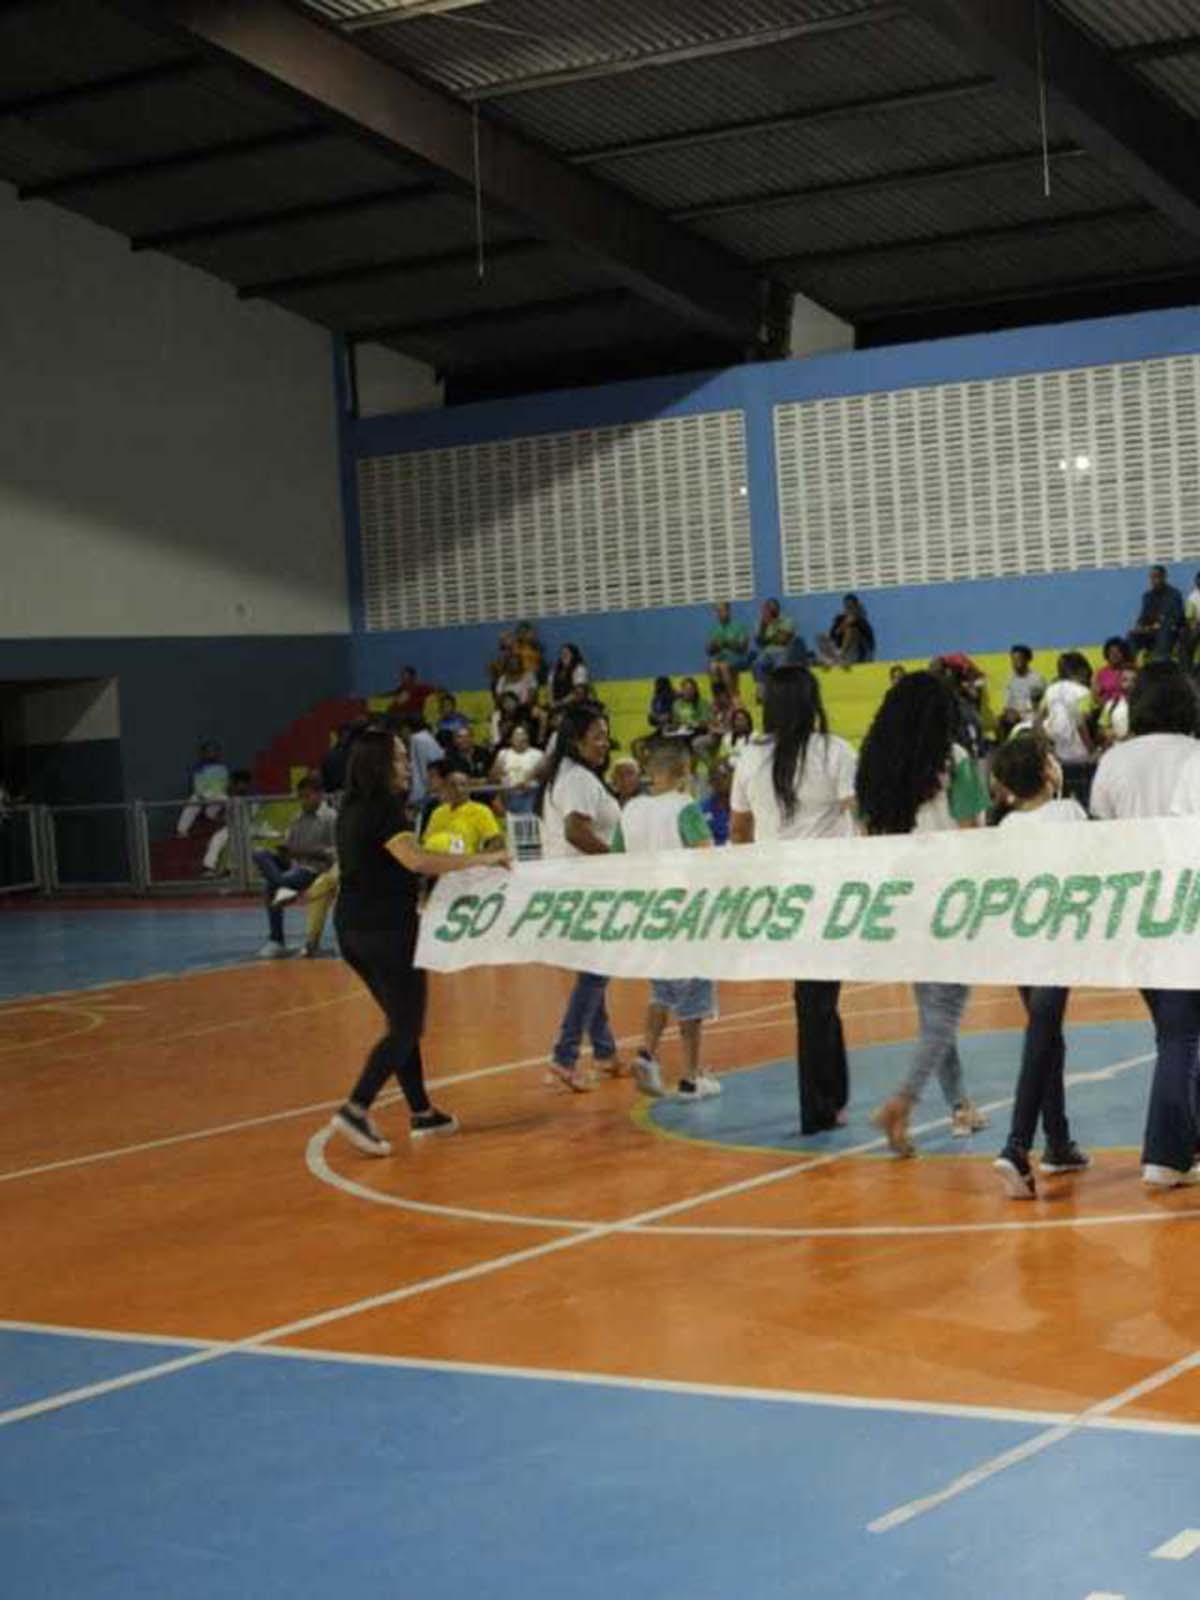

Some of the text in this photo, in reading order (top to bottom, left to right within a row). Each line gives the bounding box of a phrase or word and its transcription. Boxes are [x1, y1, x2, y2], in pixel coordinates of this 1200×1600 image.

[434, 882, 508, 942] SÓ
[508, 884, 814, 941] PRECISAMOS
[822, 879, 914, 941] DE
